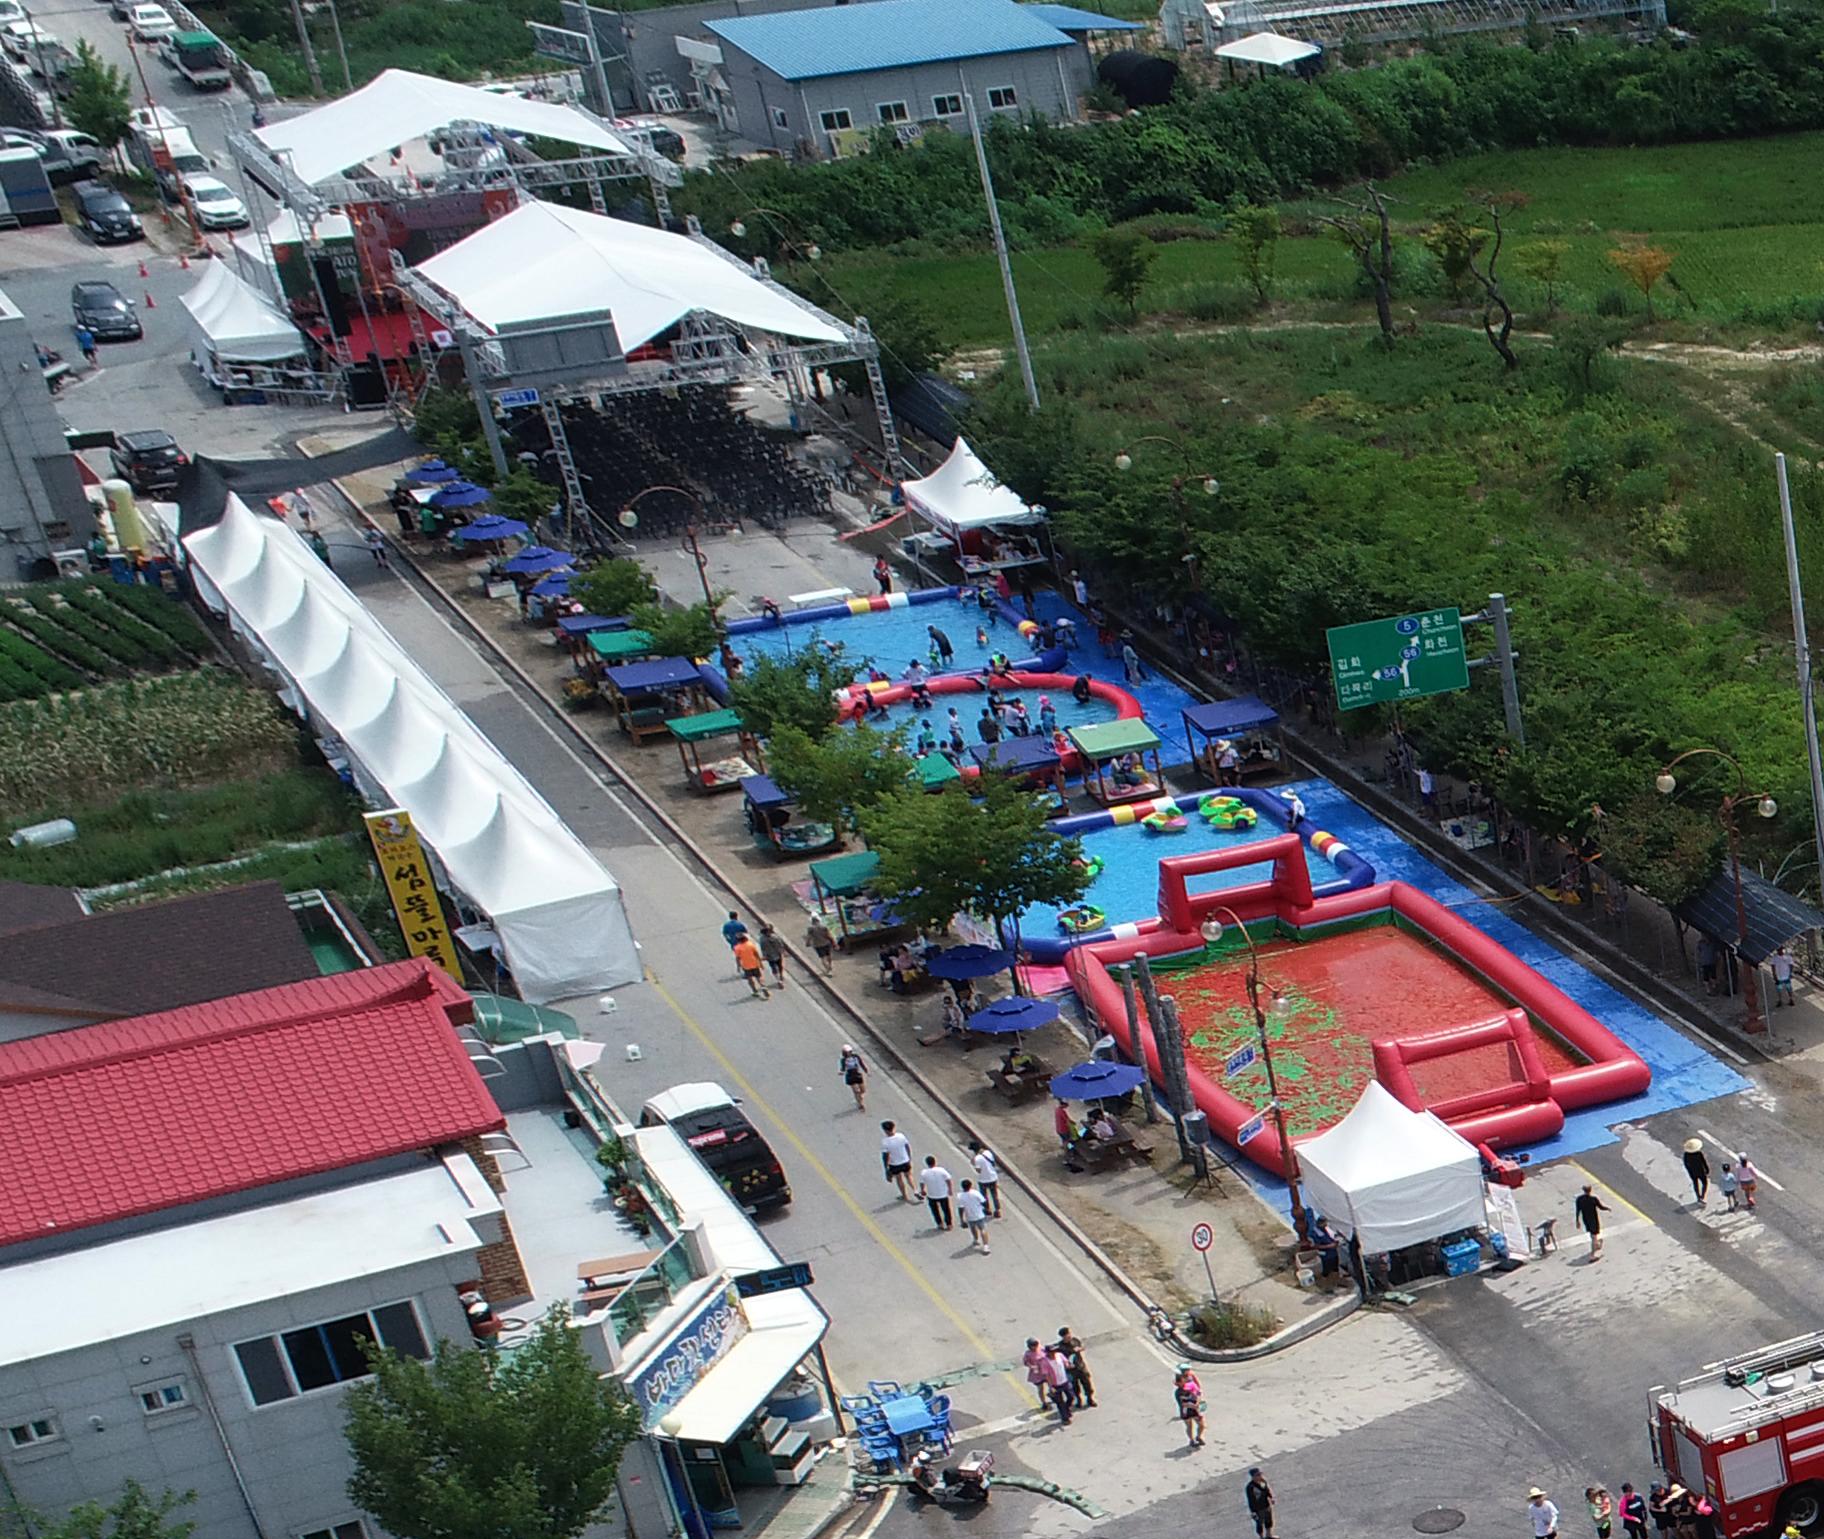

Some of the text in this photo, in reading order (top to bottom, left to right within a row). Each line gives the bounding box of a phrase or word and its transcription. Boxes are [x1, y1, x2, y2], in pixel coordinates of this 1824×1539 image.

[1403, 620, 1412, 631] 5
[1421, 613, 1444, 629] 춘천
[1424, 636, 1448, 650] 화천
[1403, 647, 1417, 659] 56
[1383, 666, 1398, 678] 56
